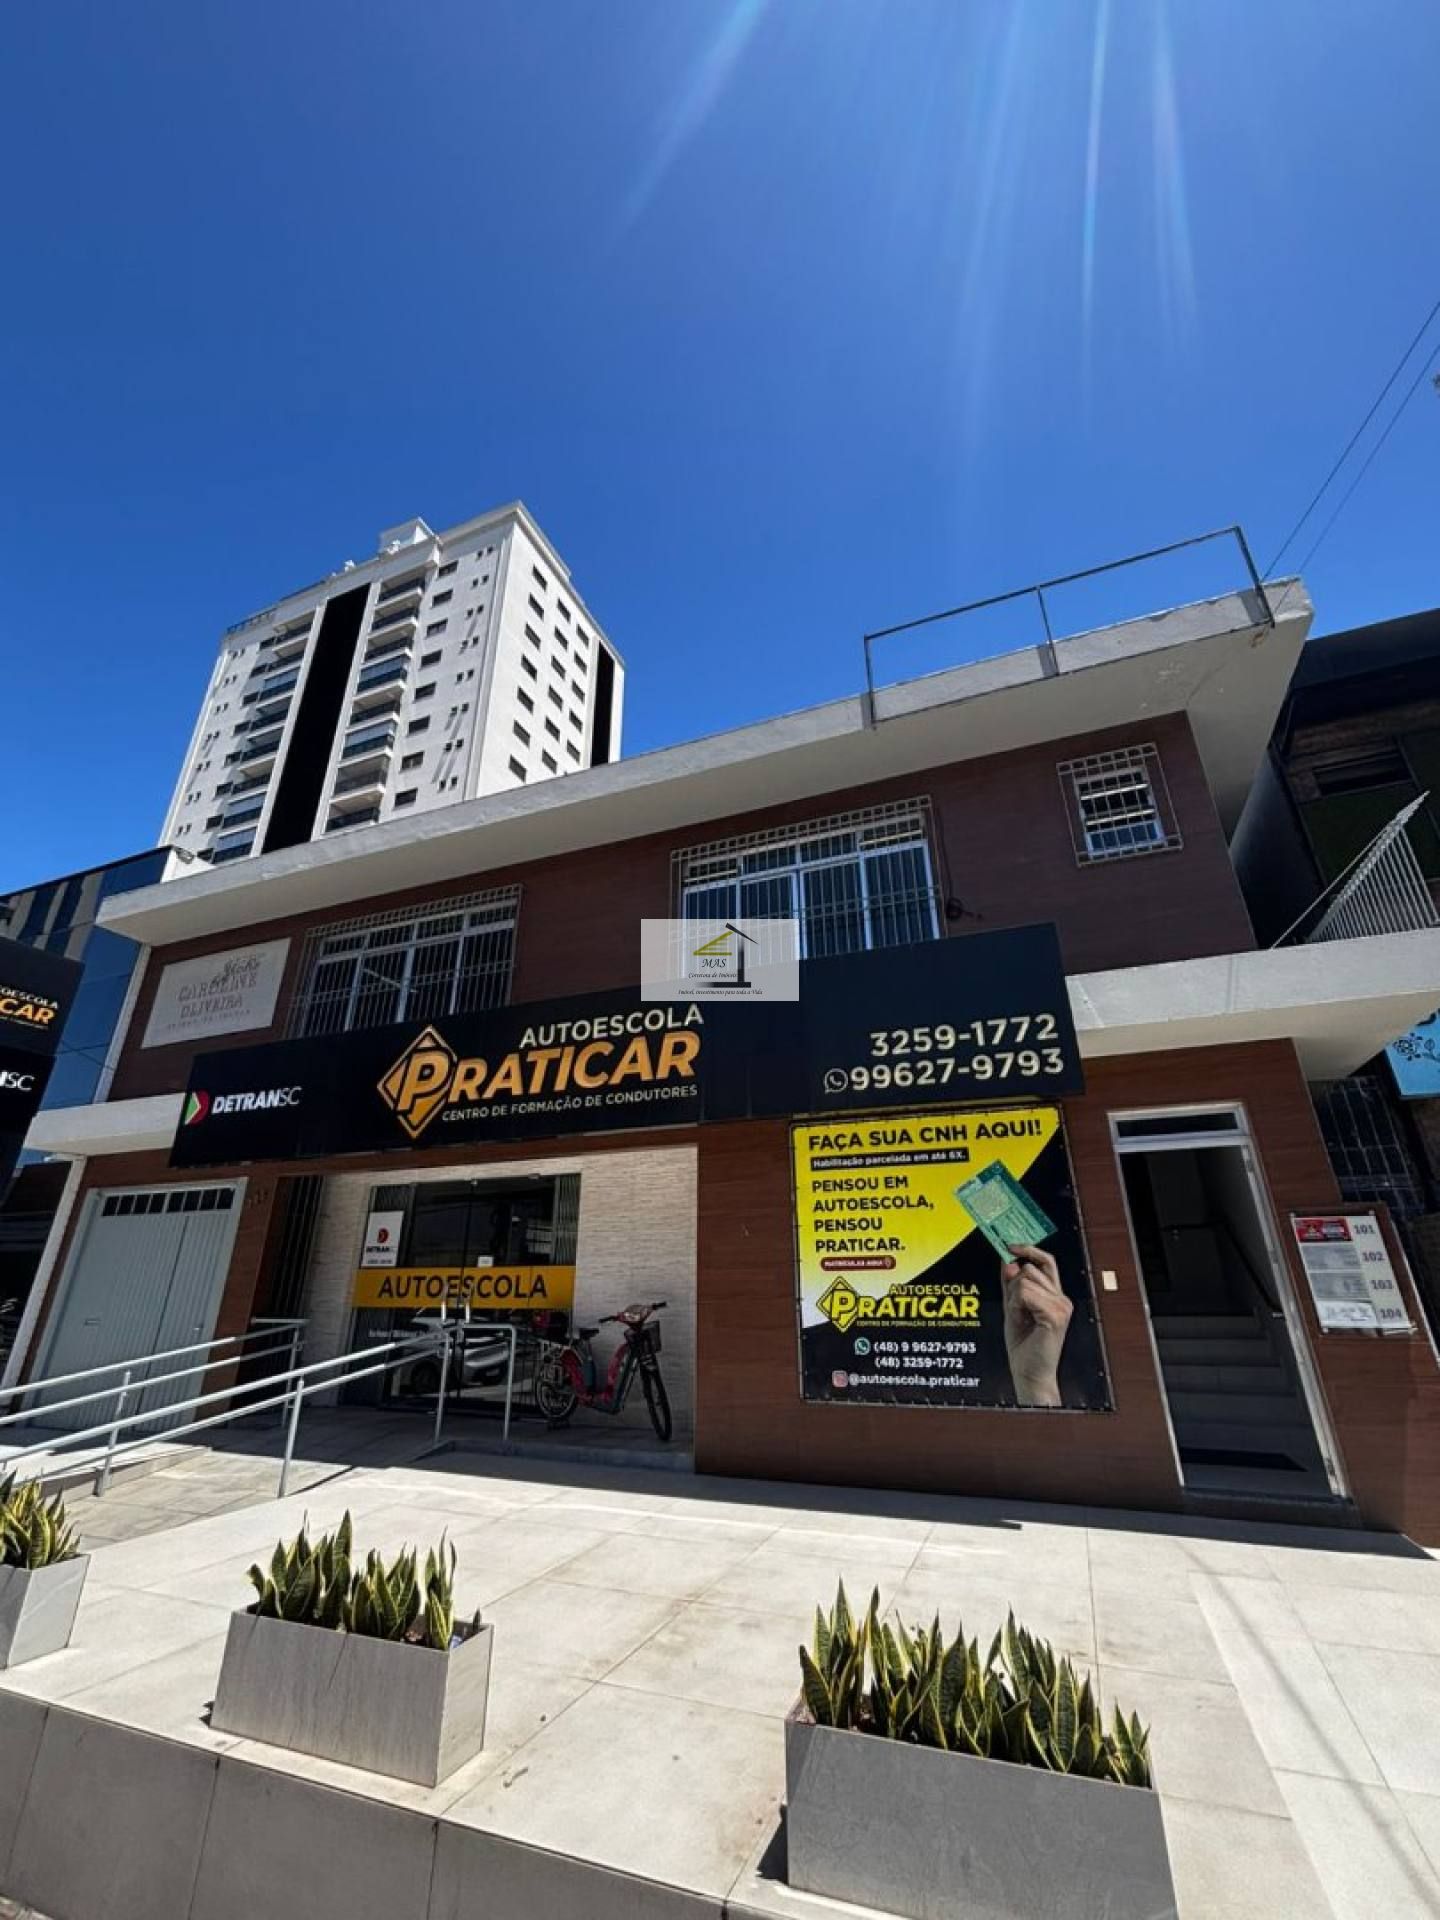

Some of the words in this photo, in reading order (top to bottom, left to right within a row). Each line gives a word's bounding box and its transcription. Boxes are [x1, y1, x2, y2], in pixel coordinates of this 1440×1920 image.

[0, 984, 59, 1010] OESCOLA
[519, 1003, 705, 1050] AUTOESCOLA
[869, 1013, 1060, 1058] 3259-1772
[397, 1030, 702, 1111] PRATICAR
[850, 1047, 1065, 1092] 99627-9793
[441, 1106, 489, 1122] CENTRO
[491, 1105, 508, 1117] DE
[511, 1096, 582, 1115] FORMAÇÃO
[584, 1095, 602, 1108] DE
[605, 1084, 699, 1106] CONDUTORES
[808, 1131, 864, 1152] FAÇA
[868, 1127, 914, 1147] SUA
[918, 1122, 969, 1143] CNH
[975, 1118, 1044, 1140] AQUI!
[812, 1156, 865, 1169] Habilitação
[865, 1153, 912, 1167] parcelada
[913, 1153, 929, 1162] em
[811, 1177, 879, 1194] PENSOU
[884, 1174, 909, 1190] EM
[812, 1194, 935, 1213] AUTOESCOLA,
[813, 1216, 883, 1233] PENSOU
[1353, 1223, 1376, 1235] 101
[814, 1236, 907, 1253] PRATICAR.
[1361, 1251, 1385, 1262] 102
[377, 1273, 548, 1299] AUTOESCOLA
[888, 1283, 980, 1296] AUTOESCOLA
[831, 1290, 980, 1319] PRATICAR
[873, 1341, 899, 1355] (48)
[900, 1342, 909, 1353] 9
[911, 1341, 977, 1354] 9627-9793
[875, 1356, 901, 1370] (48)
[902, 1356, 965, 1369] 3259-1772
[848, 1372, 981, 1389] @autoescola.praticar
